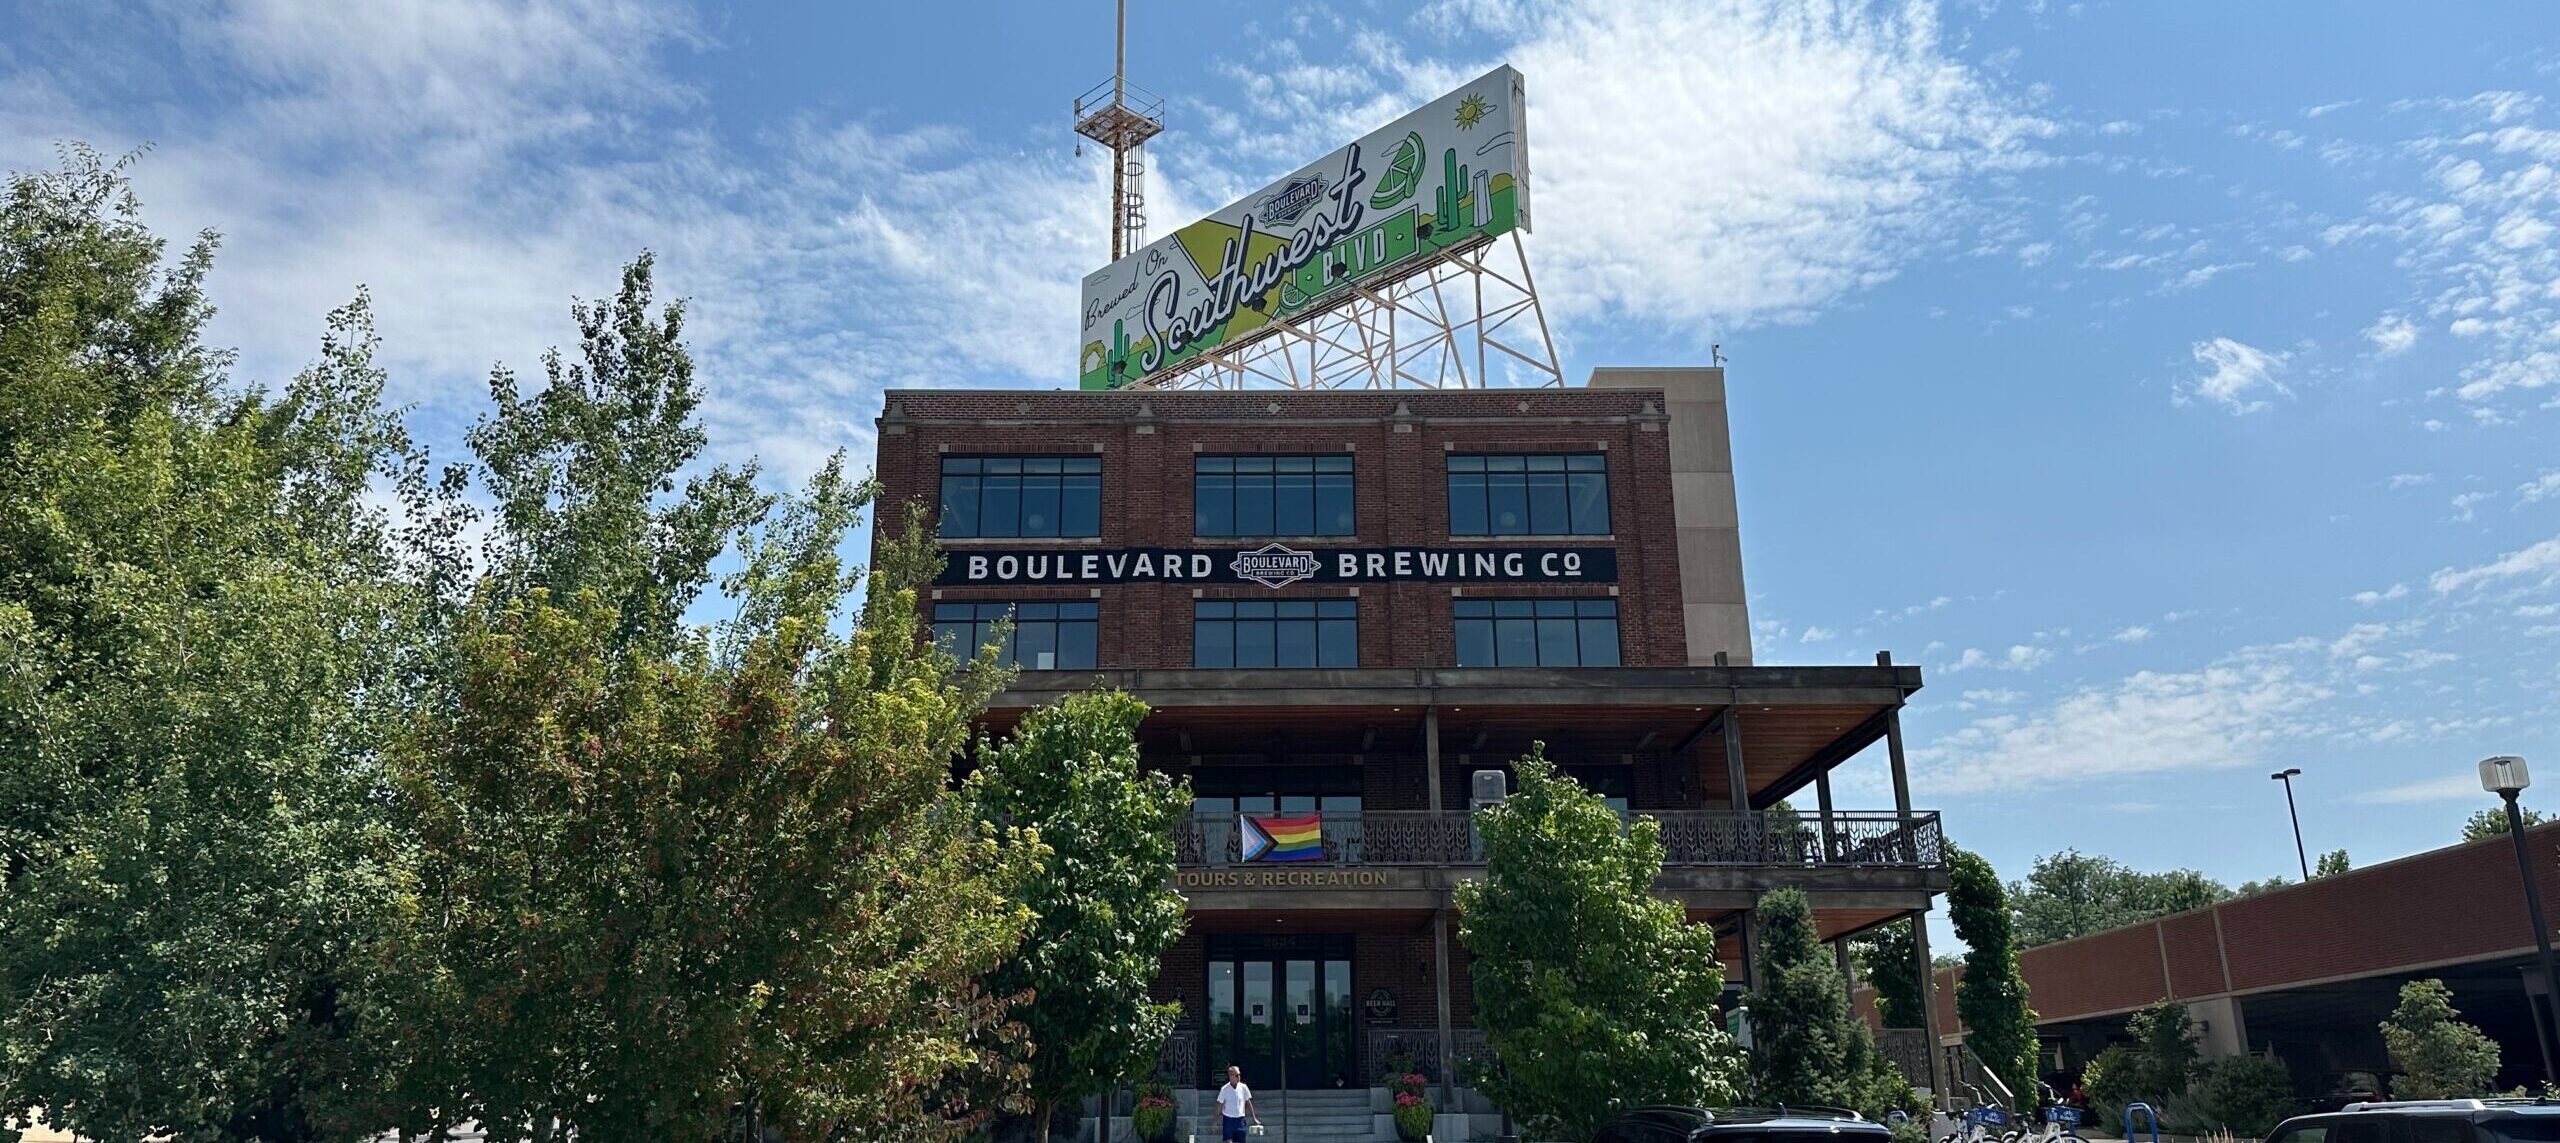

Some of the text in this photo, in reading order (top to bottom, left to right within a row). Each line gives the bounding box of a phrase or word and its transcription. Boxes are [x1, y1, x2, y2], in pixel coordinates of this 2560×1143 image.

[1268, 181, 1318, 220] BOULEVARD
[1141, 143, 1366, 374] Southwest
[1322, 227, 1386, 287] BLVD
[1085, 248, 1168, 331] Brewed On
[968, 553, 1212, 580] BOULEVARD
[1243, 556, 1308, 573] BOULEVARD
[1338, 552, 1524, 577] BREWING
[1176, 871, 1388, 886] TOURS & RECREATION
